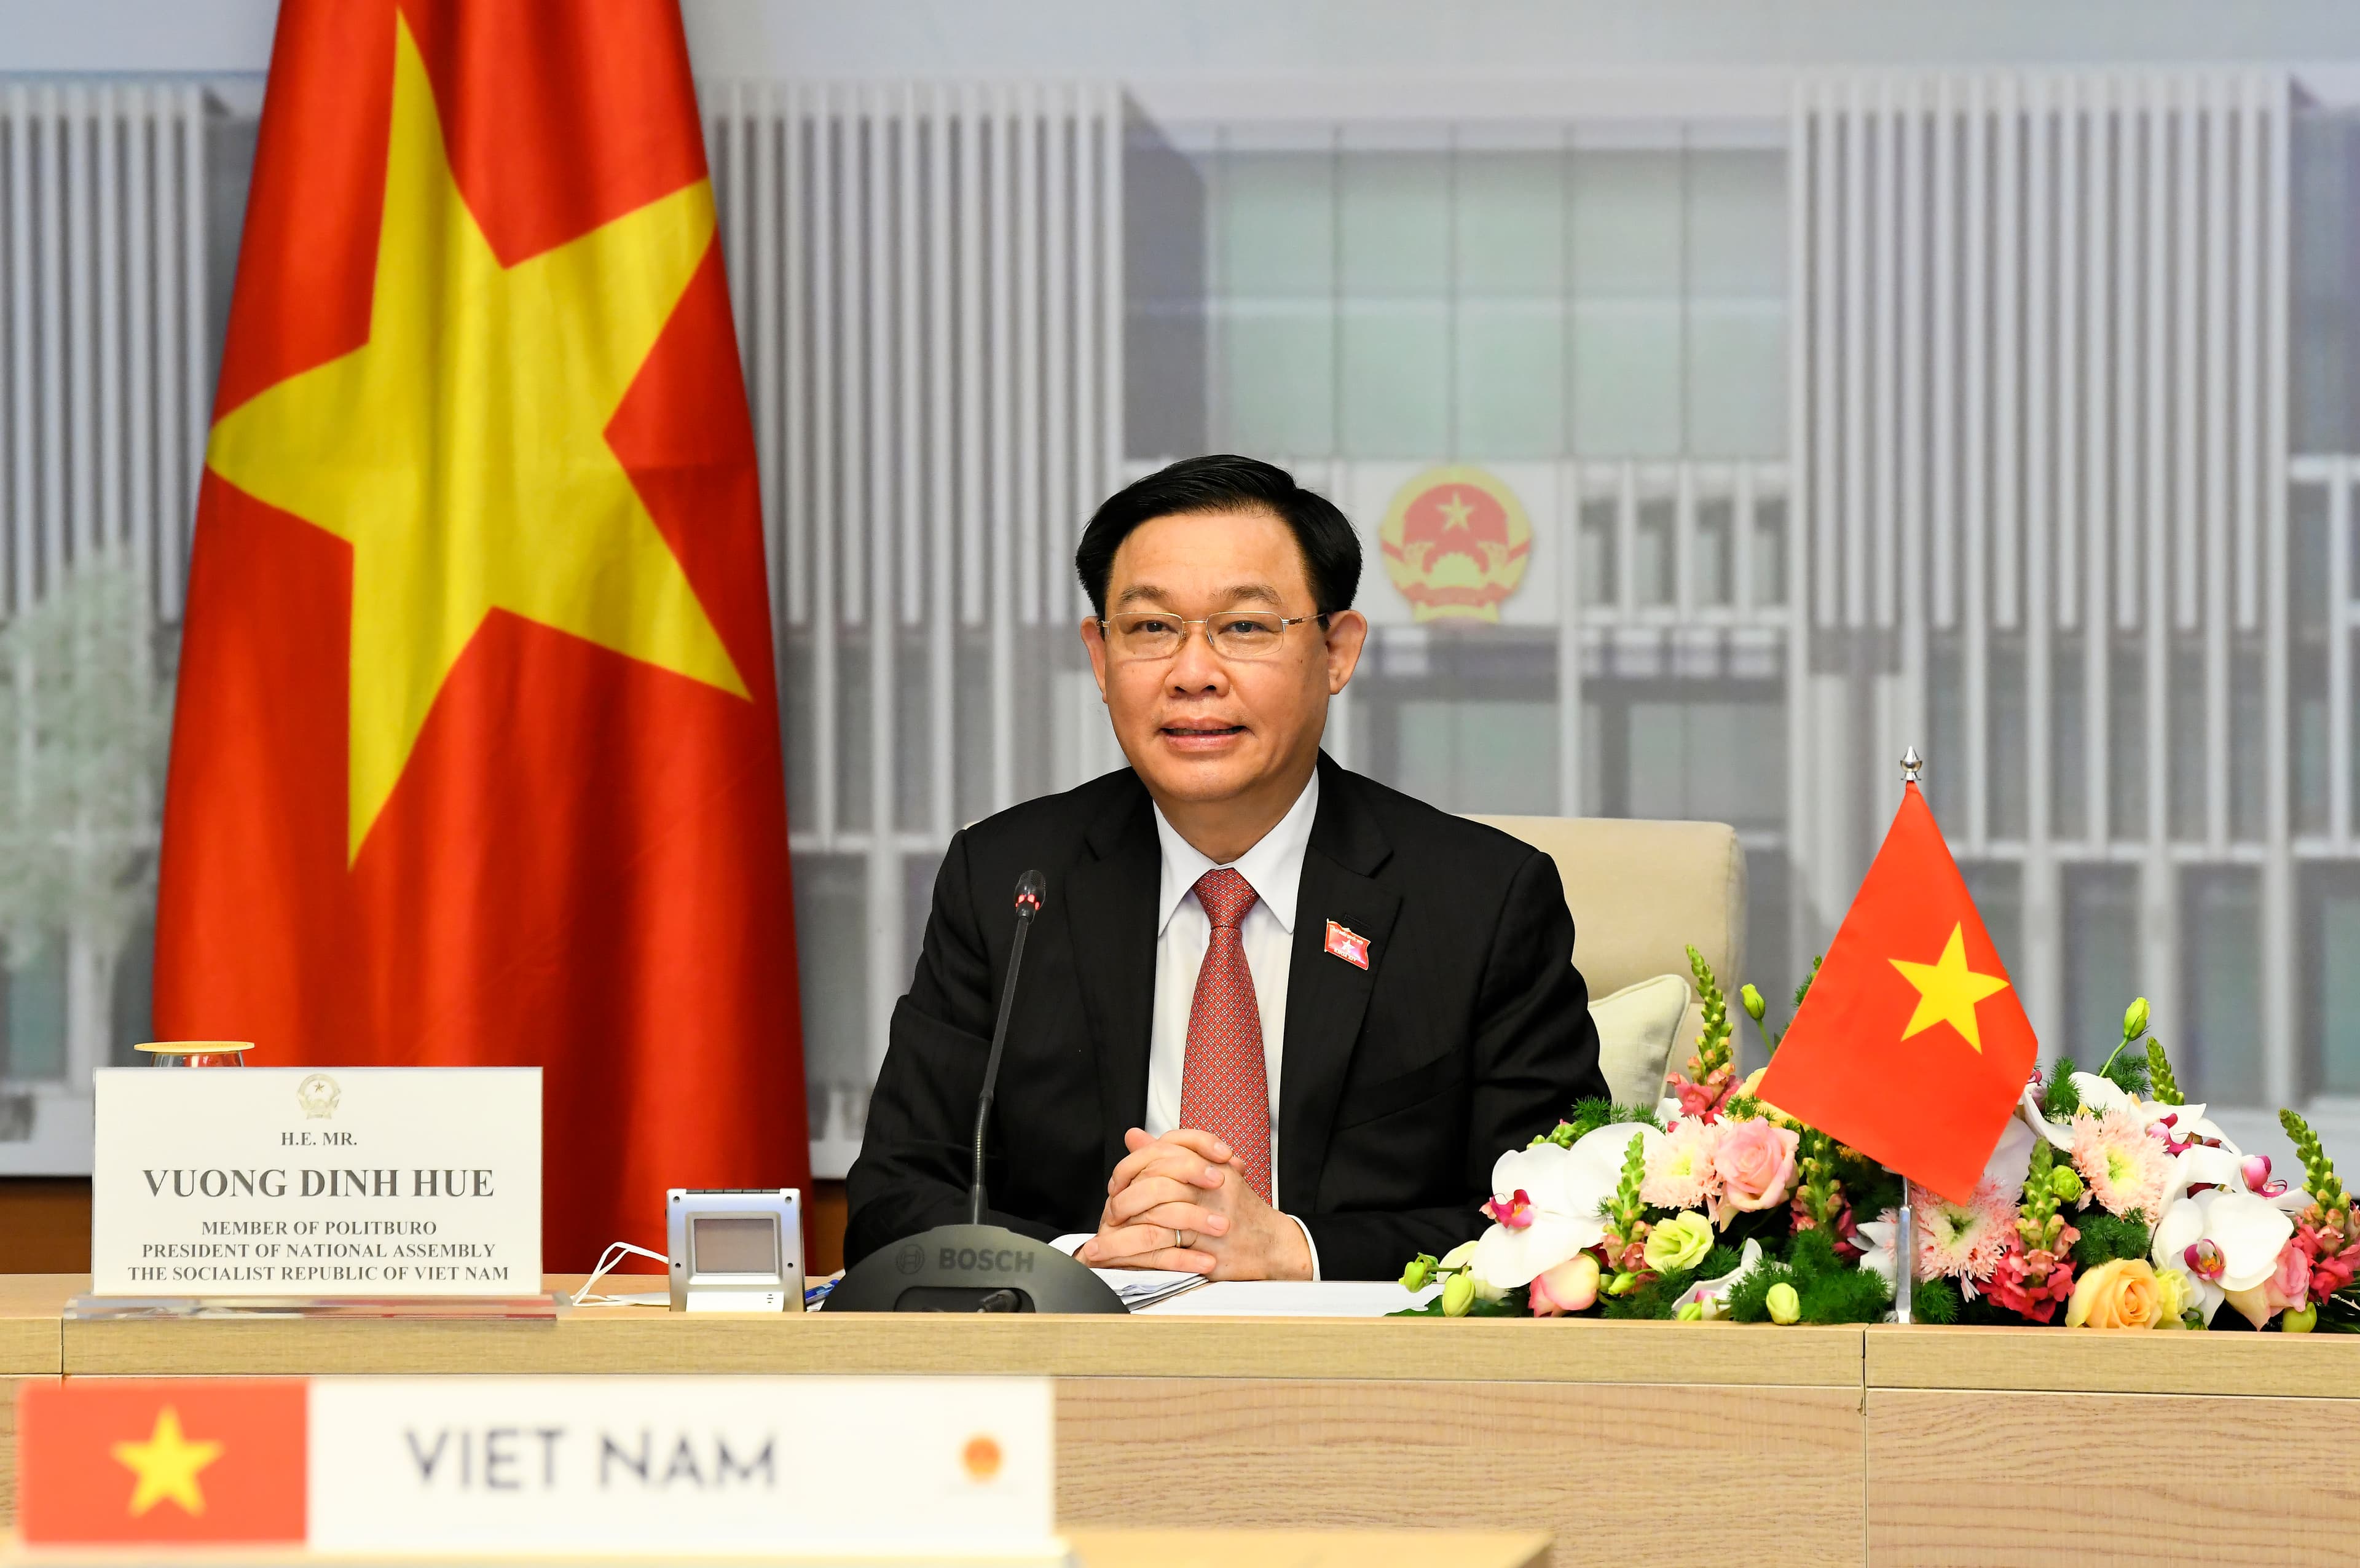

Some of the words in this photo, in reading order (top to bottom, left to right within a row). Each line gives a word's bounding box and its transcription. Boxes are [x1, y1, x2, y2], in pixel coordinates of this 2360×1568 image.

[281, 1131, 317, 1147] H.E.
[323, 1131, 358, 1147] MR.
[142, 1169, 288, 1198] VUONG
[299, 1169, 399, 1198] DINH
[412, 1169, 495, 1198] HUE
[201, 1221, 288, 1236] MEMBER
[293, 1220, 320, 1236] OF
[325, 1220, 438, 1236] POLITBURO
[142, 1243, 250, 1258] PRESIDENT
[254, 1243, 281, 1258] OF
[286, 1243, 387, 1258] NATIONAL
[393, 1243, 496, 1258] ASSEMBLY
[939, 1248, 1034, 1273] BOSCH
[128, 1266, 168, 1281] THE
[172, 1266, 276, 1281] SOCIALIST
[281, 1266, 378, 1281] REPUBLIC
[382, 1266, 409, 1280] OF
[414, 1266, 460, 1281] VIET
[465, 1266, 509, 1281] NAM
[406, 1426, 567, 1490] VIET
[599, 1430, 778, 1489] NAM
